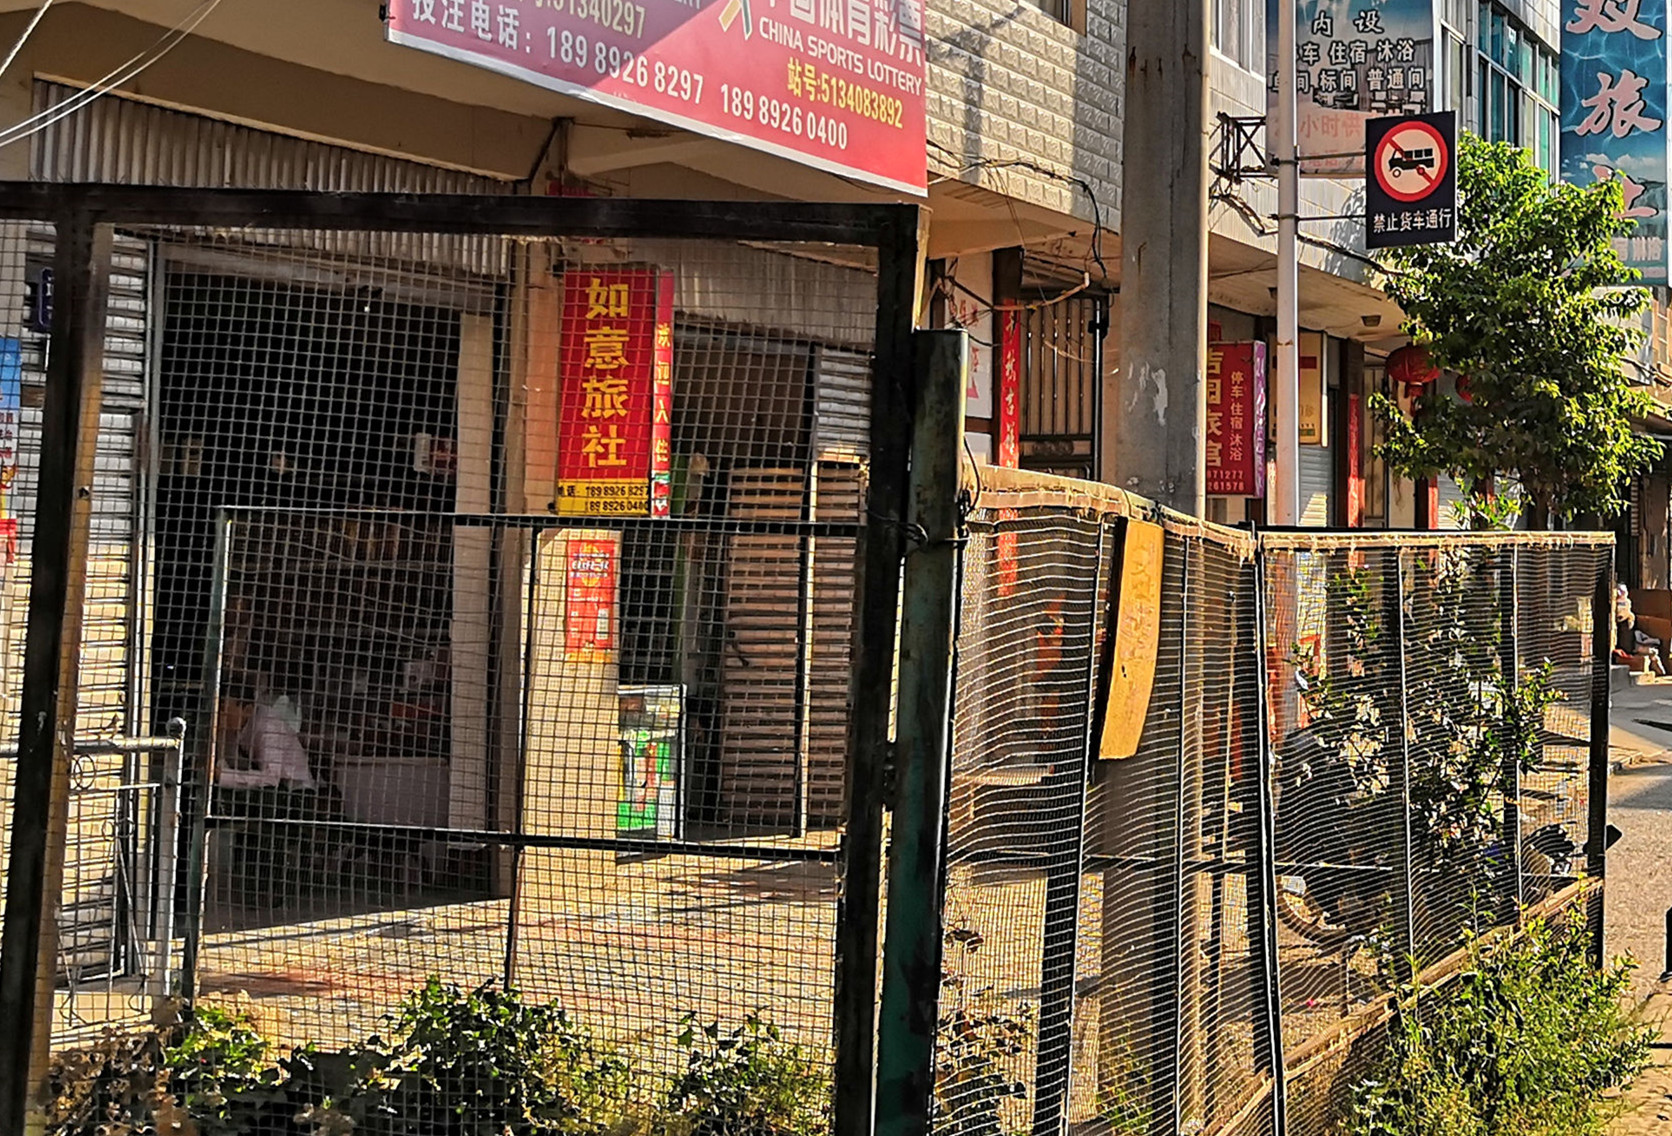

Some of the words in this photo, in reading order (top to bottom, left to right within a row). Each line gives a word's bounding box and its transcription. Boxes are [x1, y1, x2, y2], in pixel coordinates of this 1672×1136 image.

[547, 26, 589, 69] 189
[594, 39, 649, 86] 8926
[654, 54, 705, 105] 8297
[721, 83, 754, 120] 189
[758, 96, 802, 136] 8926
[807, 112, 848, 150] 0400
[759, 16, 803, 52] CHINA
[808, 35, 864, 75] SPORTS
[868, 58, 923, 96] LOTTERY
[1319, 68, 1357, 92] 标间
[1367, 66, 1426, 91] 普通间
[1329, 41, 1367, 65] 住宿
[1376, 39, 1415, 63] 沐浴
[787, 56, 903, 129] 站号:5134083892
[1373, 208, 1452, 234] 禁止货车通行
[581, 278, 630, 468] 如意旅社
